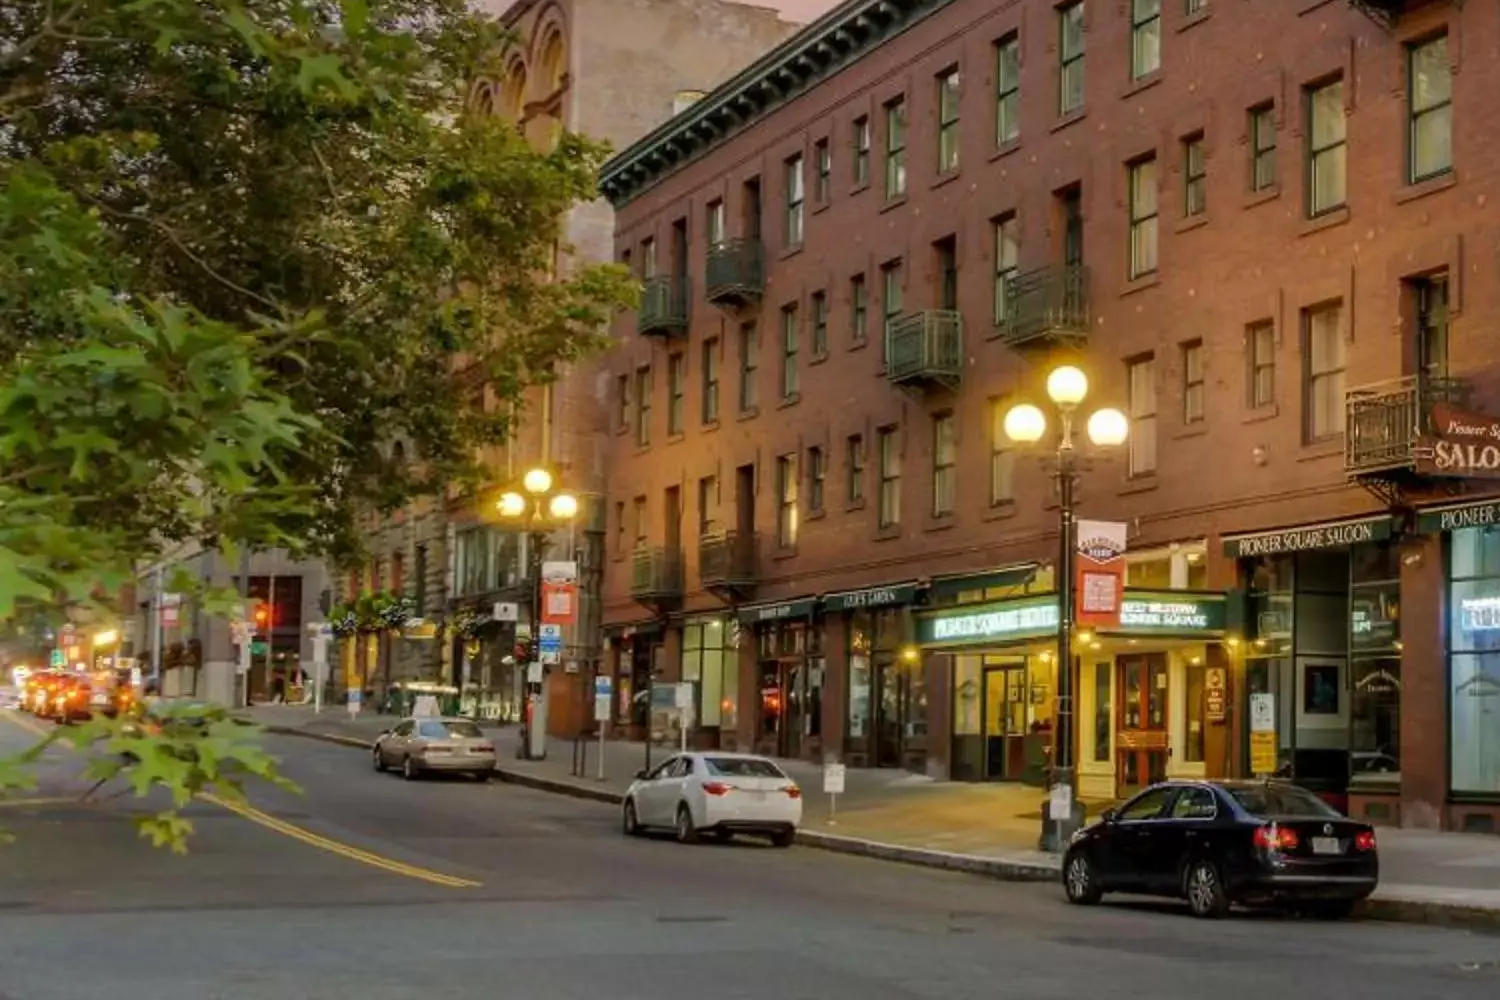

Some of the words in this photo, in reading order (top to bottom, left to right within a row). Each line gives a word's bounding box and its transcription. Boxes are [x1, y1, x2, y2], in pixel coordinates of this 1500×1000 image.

[1441, 505, 1499, 529] PIONEER
[1239, 535, 1281, 556] PIONEER
[1283, 529, 1325, 551] SQUARE
[1326, 522, 1373, 545] SALOON
